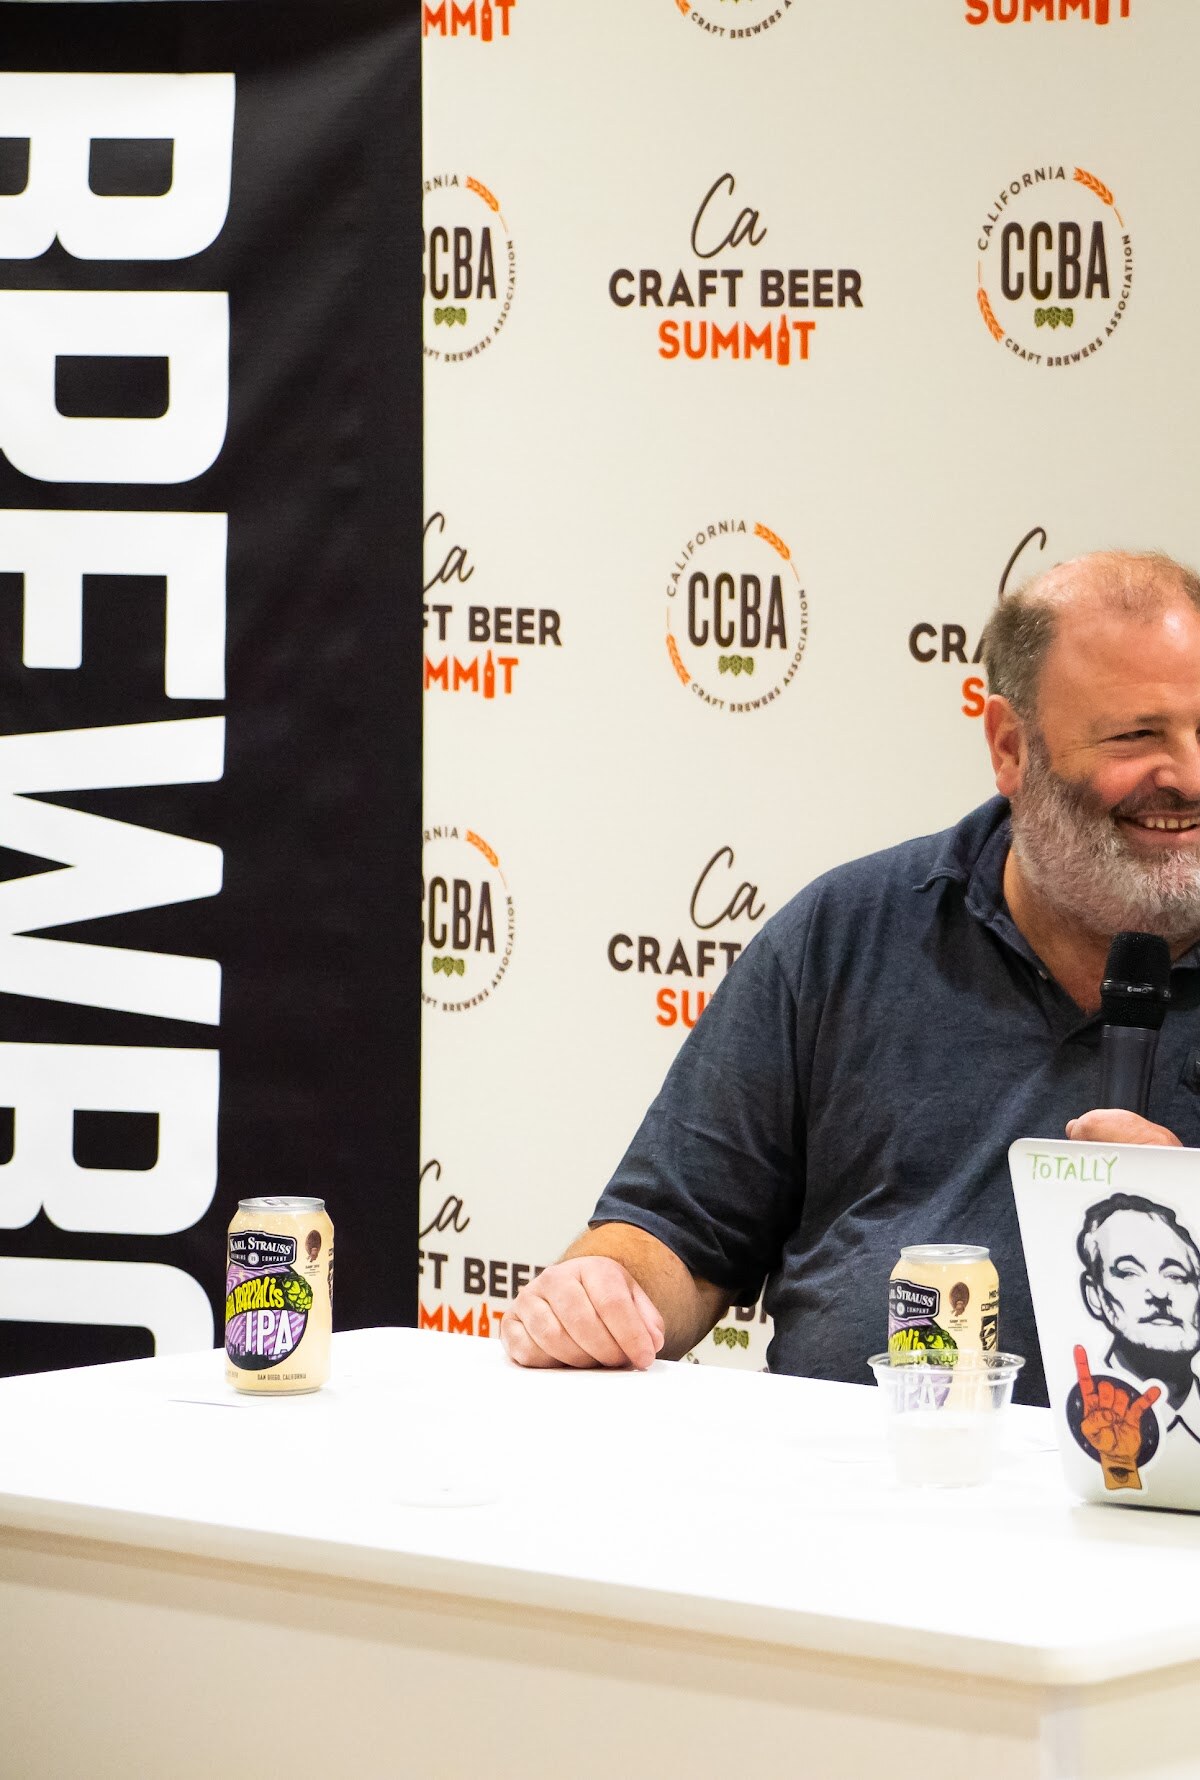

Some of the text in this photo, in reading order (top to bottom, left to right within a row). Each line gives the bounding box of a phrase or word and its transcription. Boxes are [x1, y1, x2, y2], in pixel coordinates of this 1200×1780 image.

[691, 9, 782, 39] CRAFT BREWERS
[691, 173, 767, 259] Ca
[978, 166, 1065, 251] CALIFORNIA
[422, 226, 497, 300] CBA
[608, 268, 864, 307] CRAFT BEER
[1001, 221, 1110, 301] CCBA
[444, 240, 515, 362] BREWERS ASSOCIATION
[1005, 234, 1133, 367] CRAFT BREWERS ASSOCIATION
[658, 314, 816, 365] SUMMIT
[667, 519, 746, 597] CALIFORNIA
[469, 606, 562, 646] BEER
[688, 571, 787, 650] CCBA
[692, 589, 808, 713] CRAFT BREWERS ASSOCIATION
[422, 876, 496, 953] CBA
[690, 845, 766, 930] Ca
[442, 895, 516, 1012] BREWERS ASSOCIATION
[607, 933, 743, 978] CRAFT
[247, 1236, 292, 1256] STRAUSS
[245, 1309, 294, 1356] IPA
[896, 1285, 934, 1308] STRAUSS
